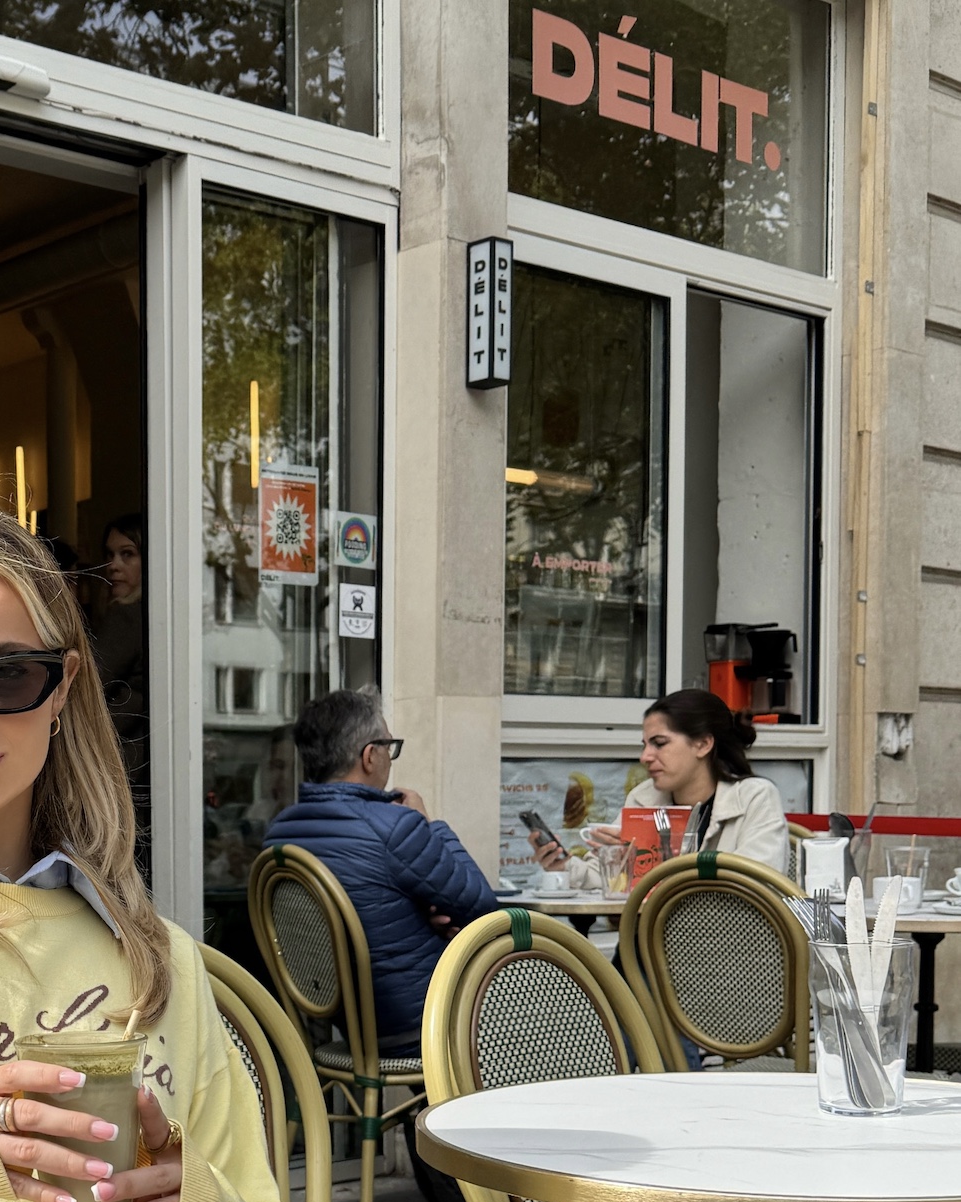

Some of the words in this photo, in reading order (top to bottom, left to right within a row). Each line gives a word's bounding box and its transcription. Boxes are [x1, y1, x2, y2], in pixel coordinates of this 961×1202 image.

[532, 8, 781, 171] DÉLIT.
[473, 259, 486, 365] DÉLIT
[497, 257, 508, 362] DÉLIT
[544, 556, 613, 574] EMPORTER
